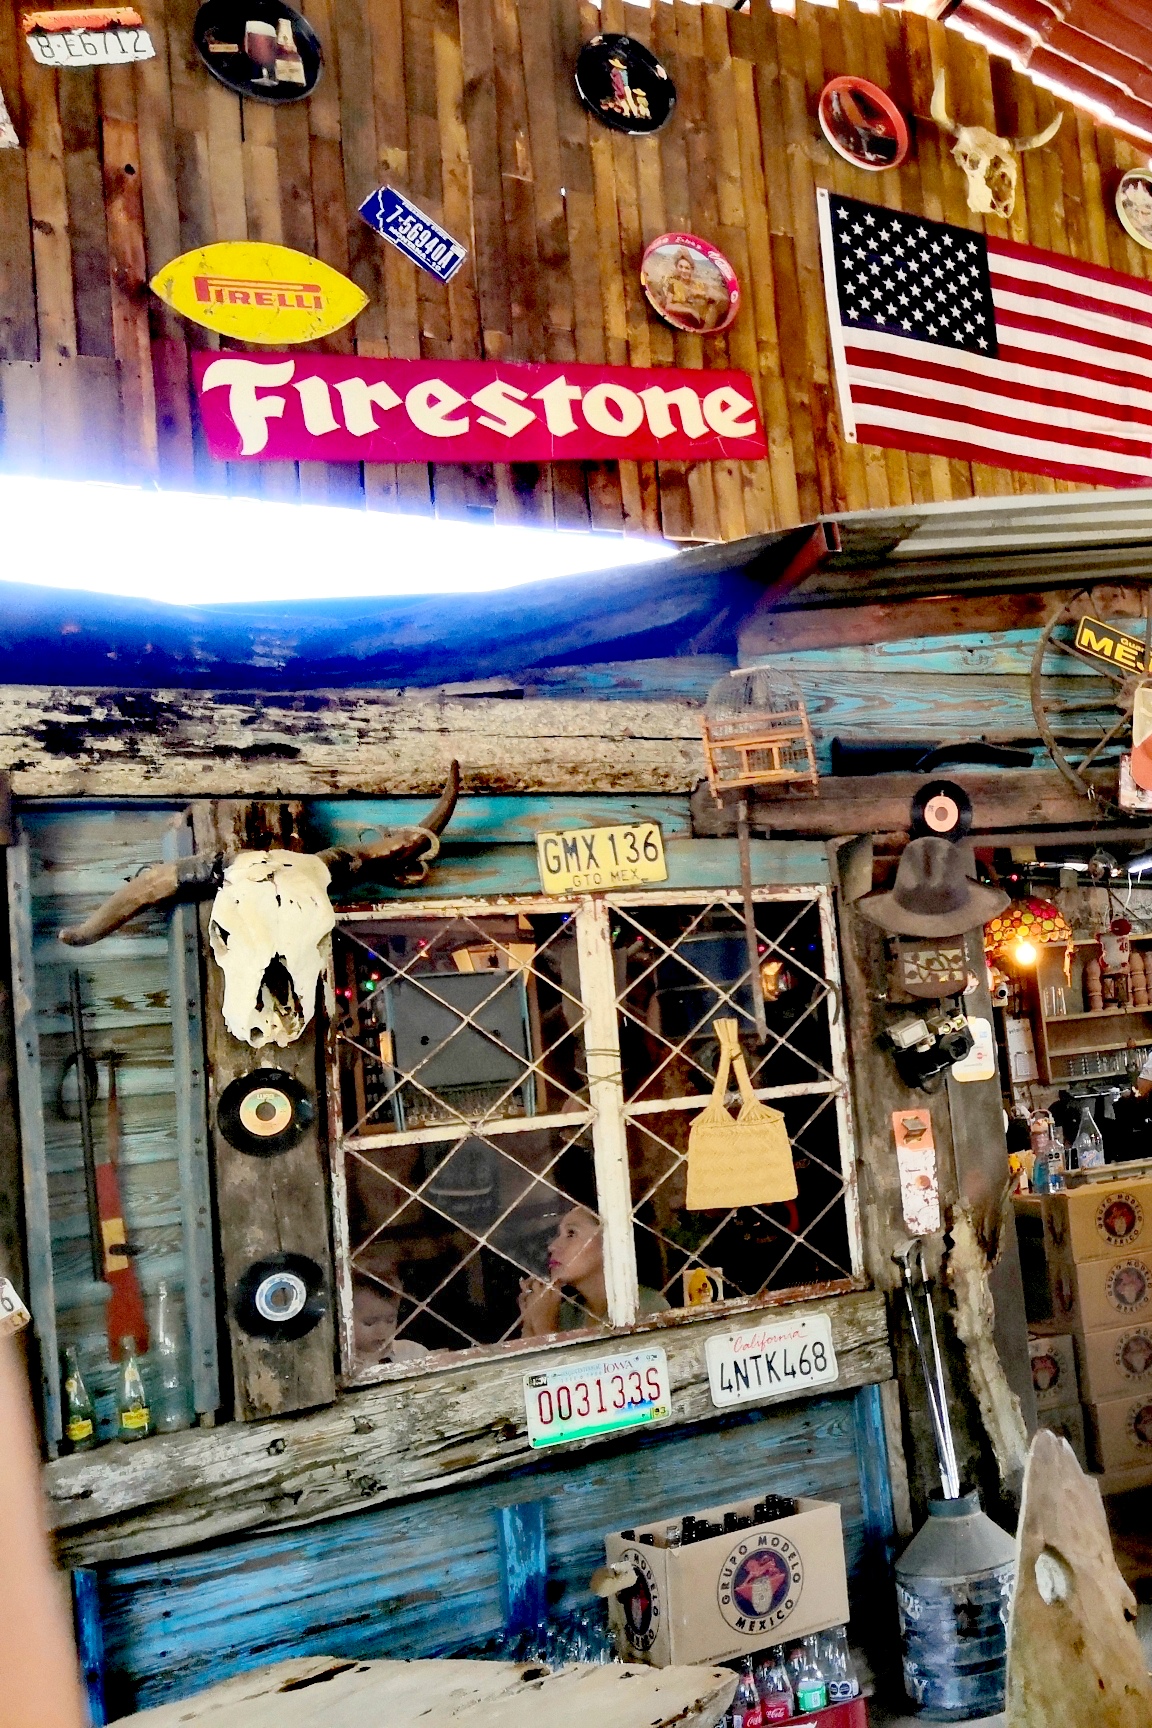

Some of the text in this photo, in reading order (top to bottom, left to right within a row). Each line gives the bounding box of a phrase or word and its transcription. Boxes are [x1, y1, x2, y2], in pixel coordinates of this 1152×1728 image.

[195, 276, 322, 309] PIRELLI
[201, 358, 757, 456] Firestone
[543, 830, 658, 874] GMX 136
[572, 868, 640, 887] GTO MEX
[733, 1329, 808, 1354] California
[603, 1360, 633, 1374] IOWA
[720, 1341, 828, 1393] 4NTK468
[537, 1367, 661, 1425] 003133S
[721, 1544, 748, 1606] GRUPO
[758, 1535, 801, 1584] MODELO
[735, 1598, 794, 1632] MEXICO
